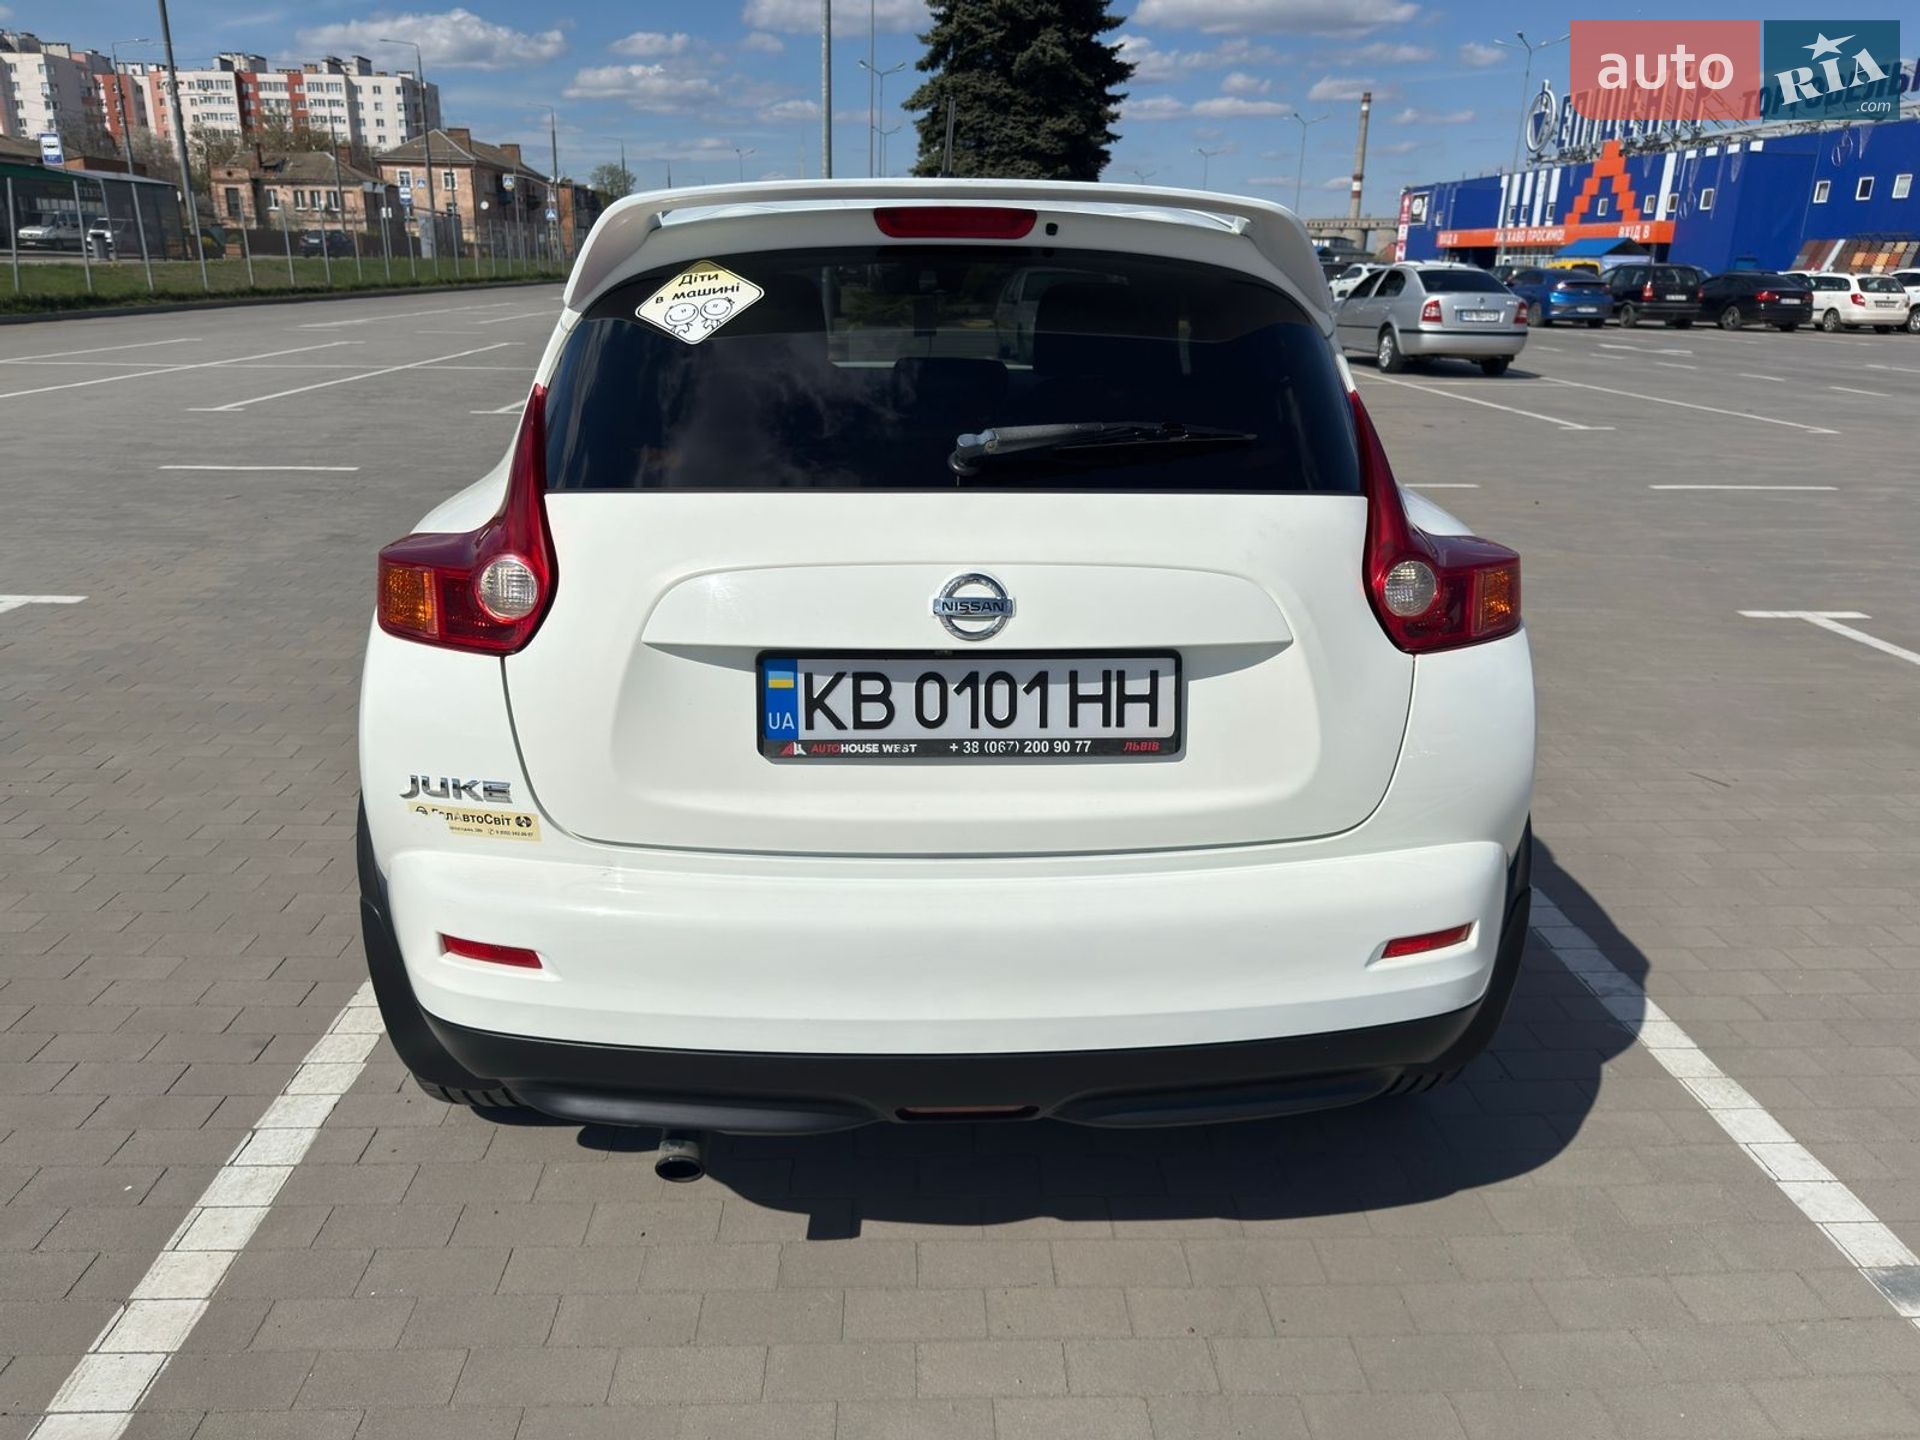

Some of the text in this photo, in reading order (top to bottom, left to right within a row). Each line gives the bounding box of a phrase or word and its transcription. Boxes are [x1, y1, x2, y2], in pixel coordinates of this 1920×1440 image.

[678, 273, 719, 287] Діти
[655, 282, 741, 304] в машині
[941, 601, 1005, 612] NISSAN
[804, 669, 1160, 731] KB 0101 HH
[768, 712, 795, 730] UA
[811, 743, 917, 753] AUTOHOUSE WEST
[963, 741, 979, 753] 38
[1024, 741, 1049, 753] 200
[1053, 741, 1071, 753] 90
[1075, 740, 1092, 753] 77
[1123, 741, 1160, 752] ЛЬВІВ
[399, 774, 513, 804] JUKE
